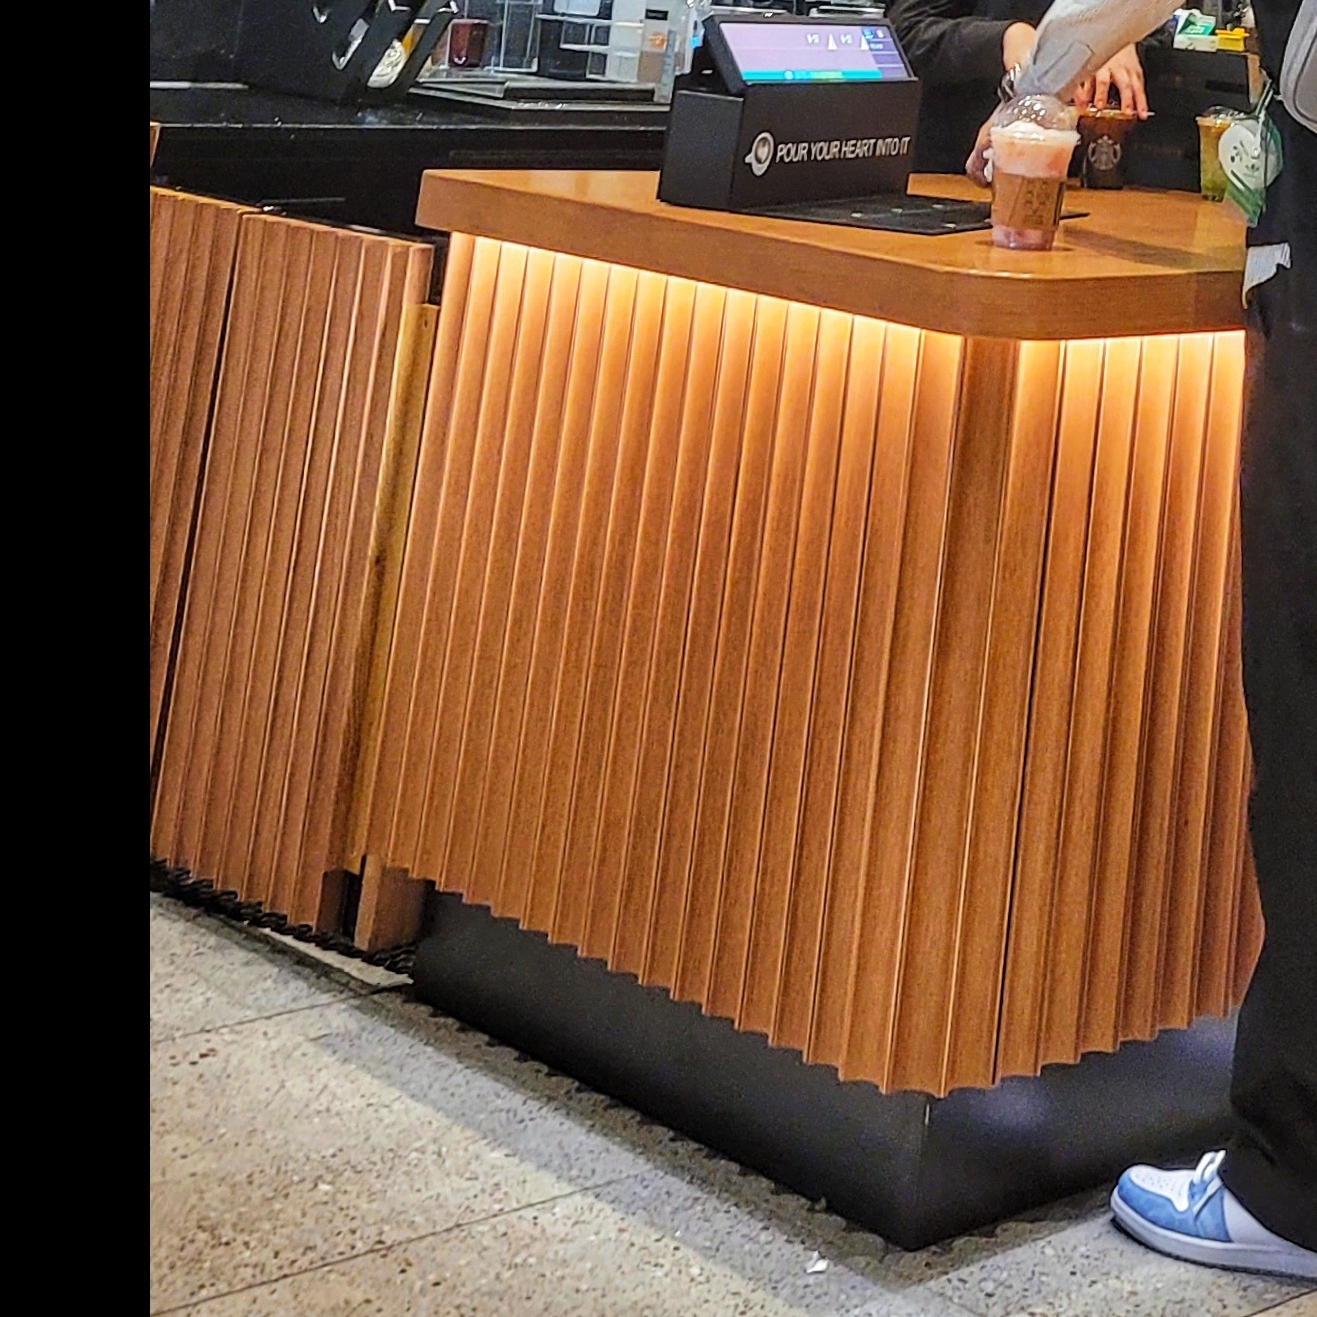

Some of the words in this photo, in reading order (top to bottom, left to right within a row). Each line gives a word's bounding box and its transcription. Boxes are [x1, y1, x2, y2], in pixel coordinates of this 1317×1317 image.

[775, 142, 809, 163] POUR
[810, 139, 841, 161] YOUR
[840, 137, 875, 159] HEART
[875, 137, 900, 157] INTO
[899, 136, 911, 156] IT
